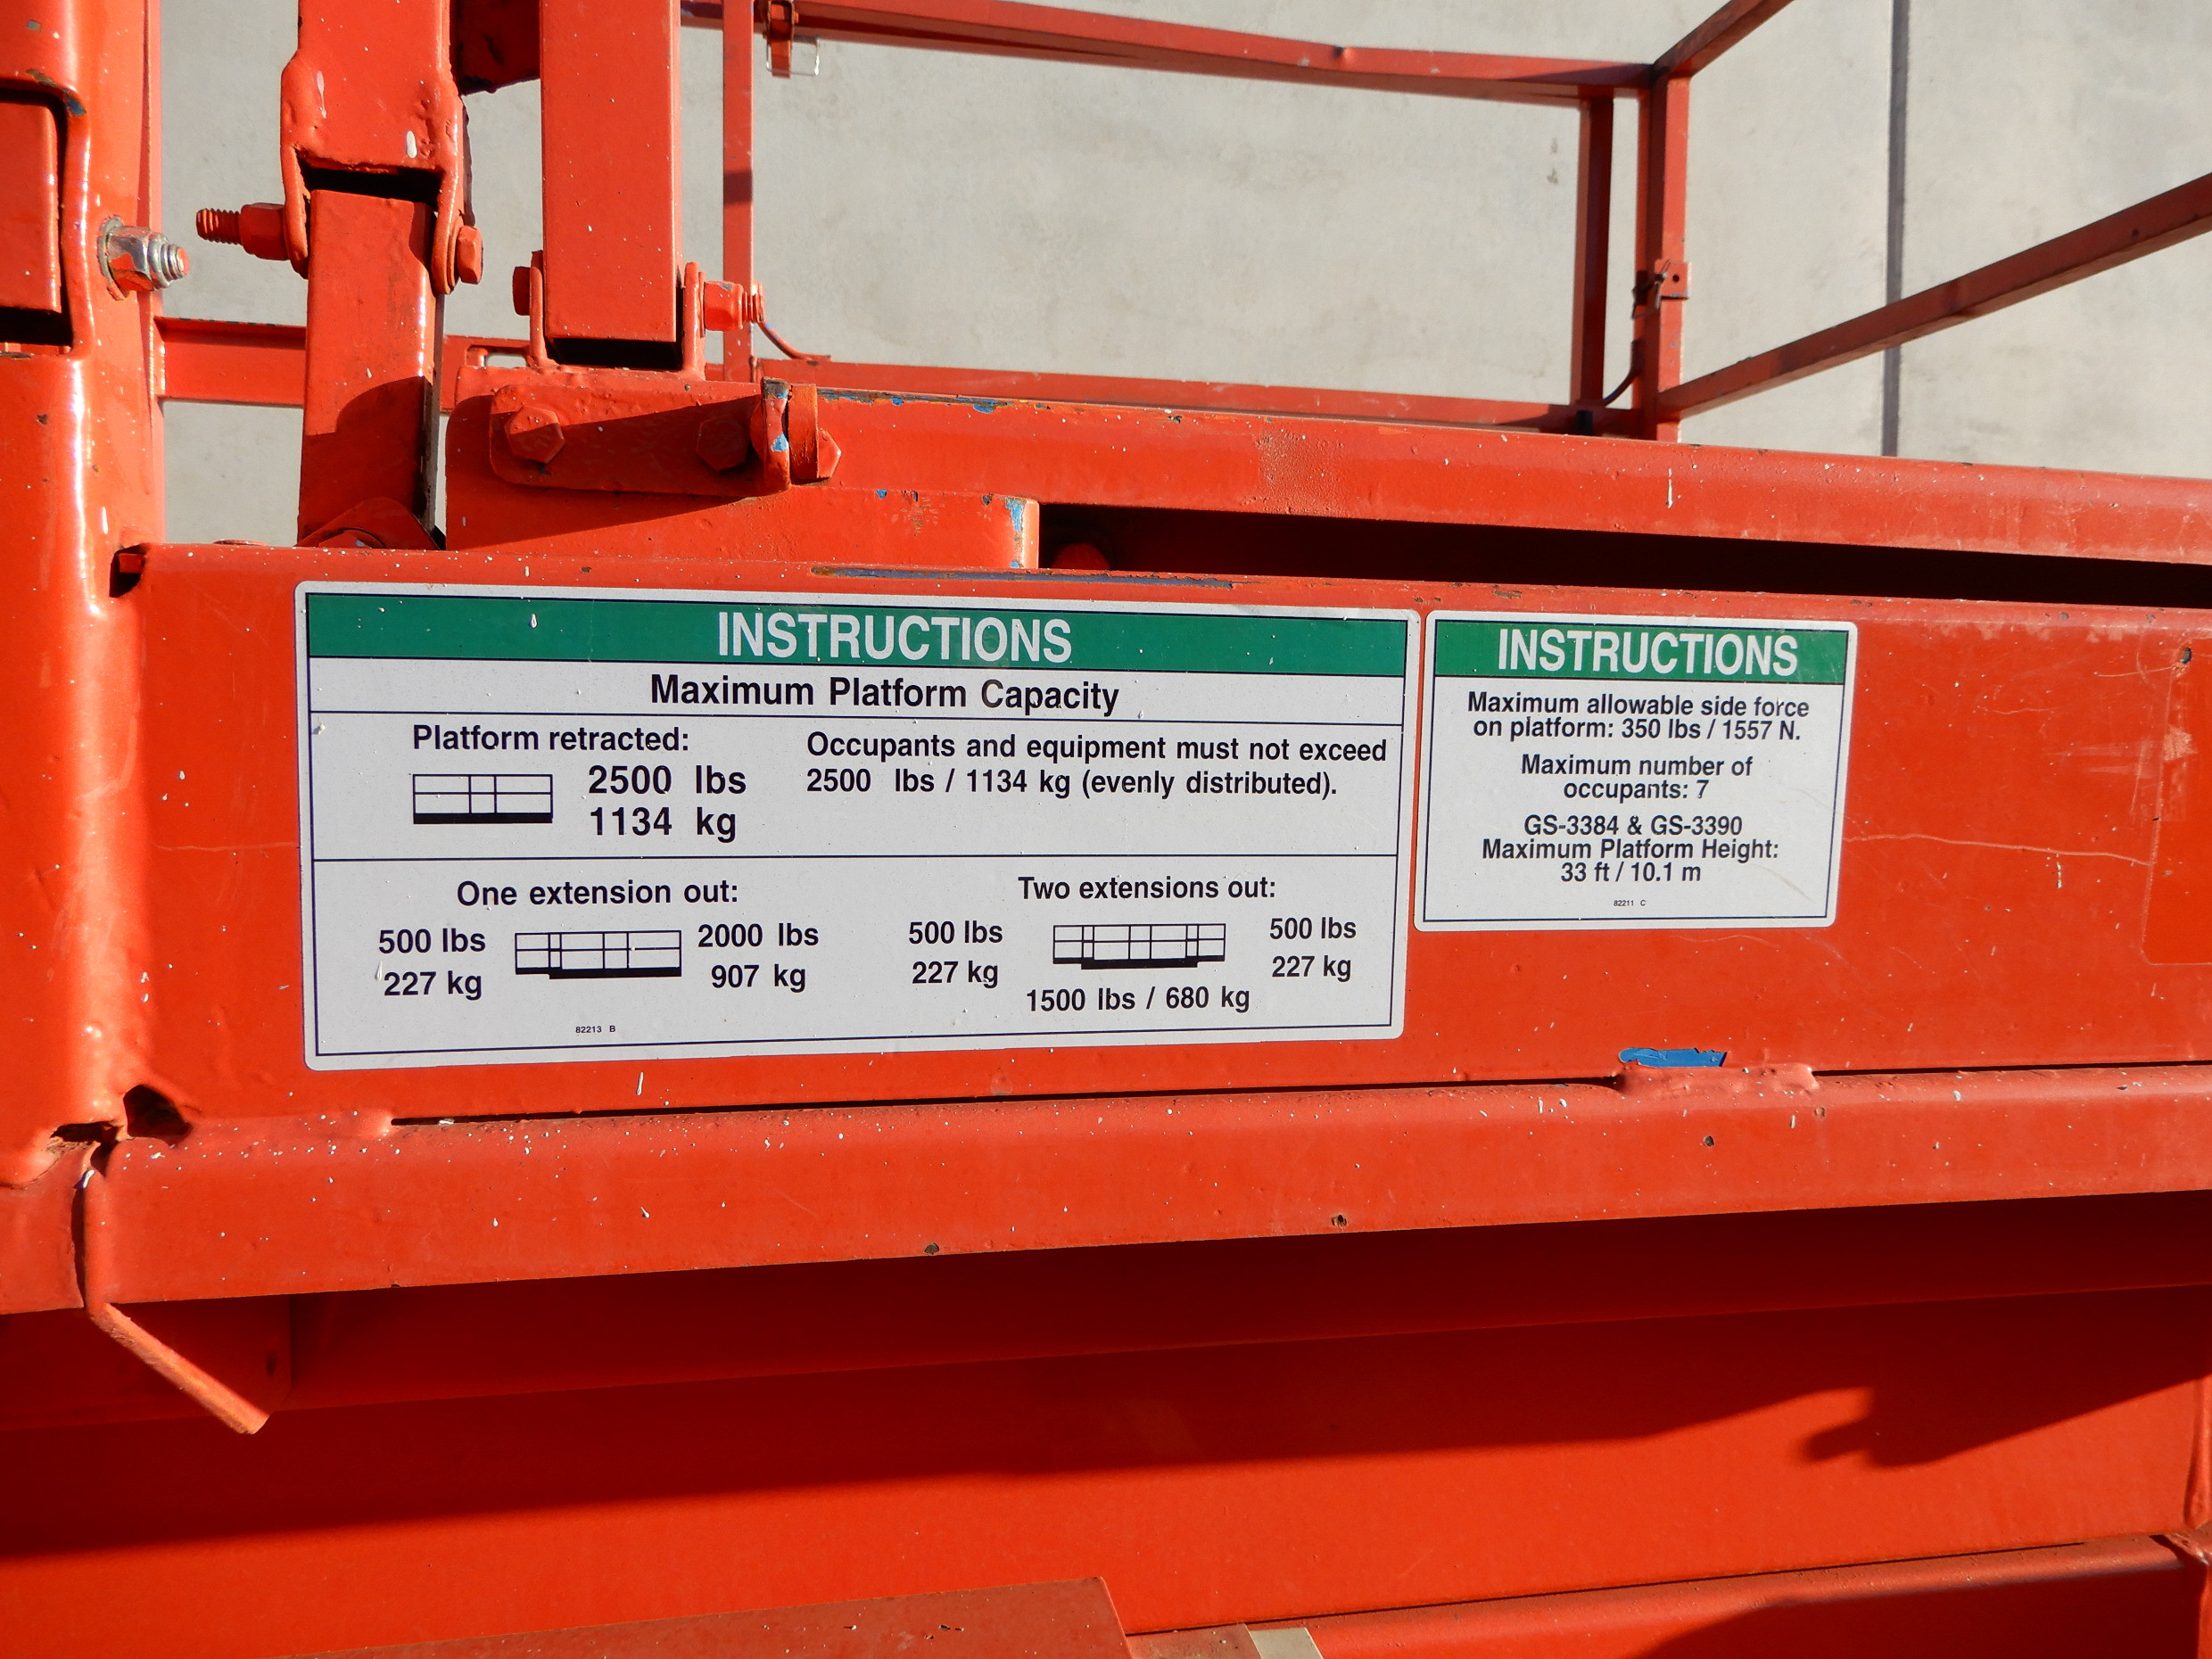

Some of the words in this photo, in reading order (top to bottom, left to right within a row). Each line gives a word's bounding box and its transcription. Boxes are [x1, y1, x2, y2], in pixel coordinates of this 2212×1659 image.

[719, 611, 1072, 664] INSTRUCTIONS
[1498, 628, 1798, 677] INSTRUCTIONS
[651, 673, 814, 706] Maximum
[830, 676, 967, 707] Platform
[981, 679, 1120, 718] Capacity
[1467, 690, 1579, 714] Maximum
[1587, 693, 1694, 716] allowable
[1700, 695, 1747, 716] side
[1754, 696, 1810, 718] force
[413, 723, 539, 750] Platform
[549, 726, 689, 752] retracted:
[1473, 720, 1502, 737] on
[1510, 715, 1614, 742] platform:
[1622, 717, 1661, 739] 350
[1668, 718, 1701, 739] lbs
[1706, 718, 1717, 739] /
[1722, 719, 1773, 740] 1557
[1779, 720, 1800, 740] N.
[807, 730, 955, 763] Occupants
[966, 733, 1016, 758] and
[1027, 734, 1167, 764] equipment
[1176, 738, 1239, 760] must
[1249, 739, 1290, 761] not
[1299, 739, 1387, 762] exceed
[1522, 753, 1631, 775] Maximum
[1638, 755, 1725, 776] number
[1731, 755, 1754, 777] of
[588, 764, 672, 795] 2500
[696, 764, 747, 795] lbs
[806, 768, 871, 793] 2500
[895, 768, 935, 793] lbs
[945, 767, 956, 793] /
[966, 769, 1028, 793] 1134
[1039, 769, 1070, 799] kg
[1082, 769, 1176, 800] (evenly
[1185, 770, 1337, 801] distributed).
[1564, 780, 1688, 805] occupants:
[1696, 779, 1710, 799] 7
[590, 806, 673, 837] 1134
[697, 806, 736, 844] kg
[1523, 813, 1620, 836] GS-3384
[1627, 815, 1642, 836] &
[1650, 814, 1743, 836] GS-3390
[1482, 838, 1592, 859] Maximum
[1600, 838, 1694, 859] Platform
[1701, 838, 1779, 864] Height:
[1561, 862, 1587, 882] 33
[1594, 861, 1610, 882] ft
[1614, 861, 1625, 882] /
[1630, 862, 1672, 882] 10.1
[1681, 866, 1701, 882] m
[457, 880, 517, 907] One
[529, 879, 671, 905] extension
[683, 879, 738, 904] out:
[1018, 876, 1070, 900] Two
[1078, 875, 1219, 900] extensions
[1227, 876, 1275, 898] out:
[1613, 899, 1634, 907] 82211
[1639, 899, 1647, 907] C
[378, 929, 432, 954] 500
[442, 928, 486, 953] lbs
[697, 923, 763, 948] 2000
[778, 922, 819, 946] lbs
[908, 920, 955, 945] 500
[964, 920, 1003, 944] lbs
[1269, 917, 1313, 940] 500
[1321, 916, 1357, 939] lbs
[711, 964, 760, 989] 907
[773, 963, 806, 994] kg
[912, 961, 959, 985] 227
[968, 960, 998, 989] kg
[1271, 955, 1316, 978] 227
[1323, 954, 1351, 983] kg
[384, 970, 437, 996] 227
[447, 970, 482, 1001] kg
[1027, 988, 1086, 1012] 1500
[1098, 987, 1135, 1011] lbs
[1145, 986, 1156, 1010] /
[1166, 986, 1209, 1010] 680
[1221, 985, 1250, 1013] kg
[574, 1025, 602, 1034] 82213
[608, 1025, 616, 1033] B
